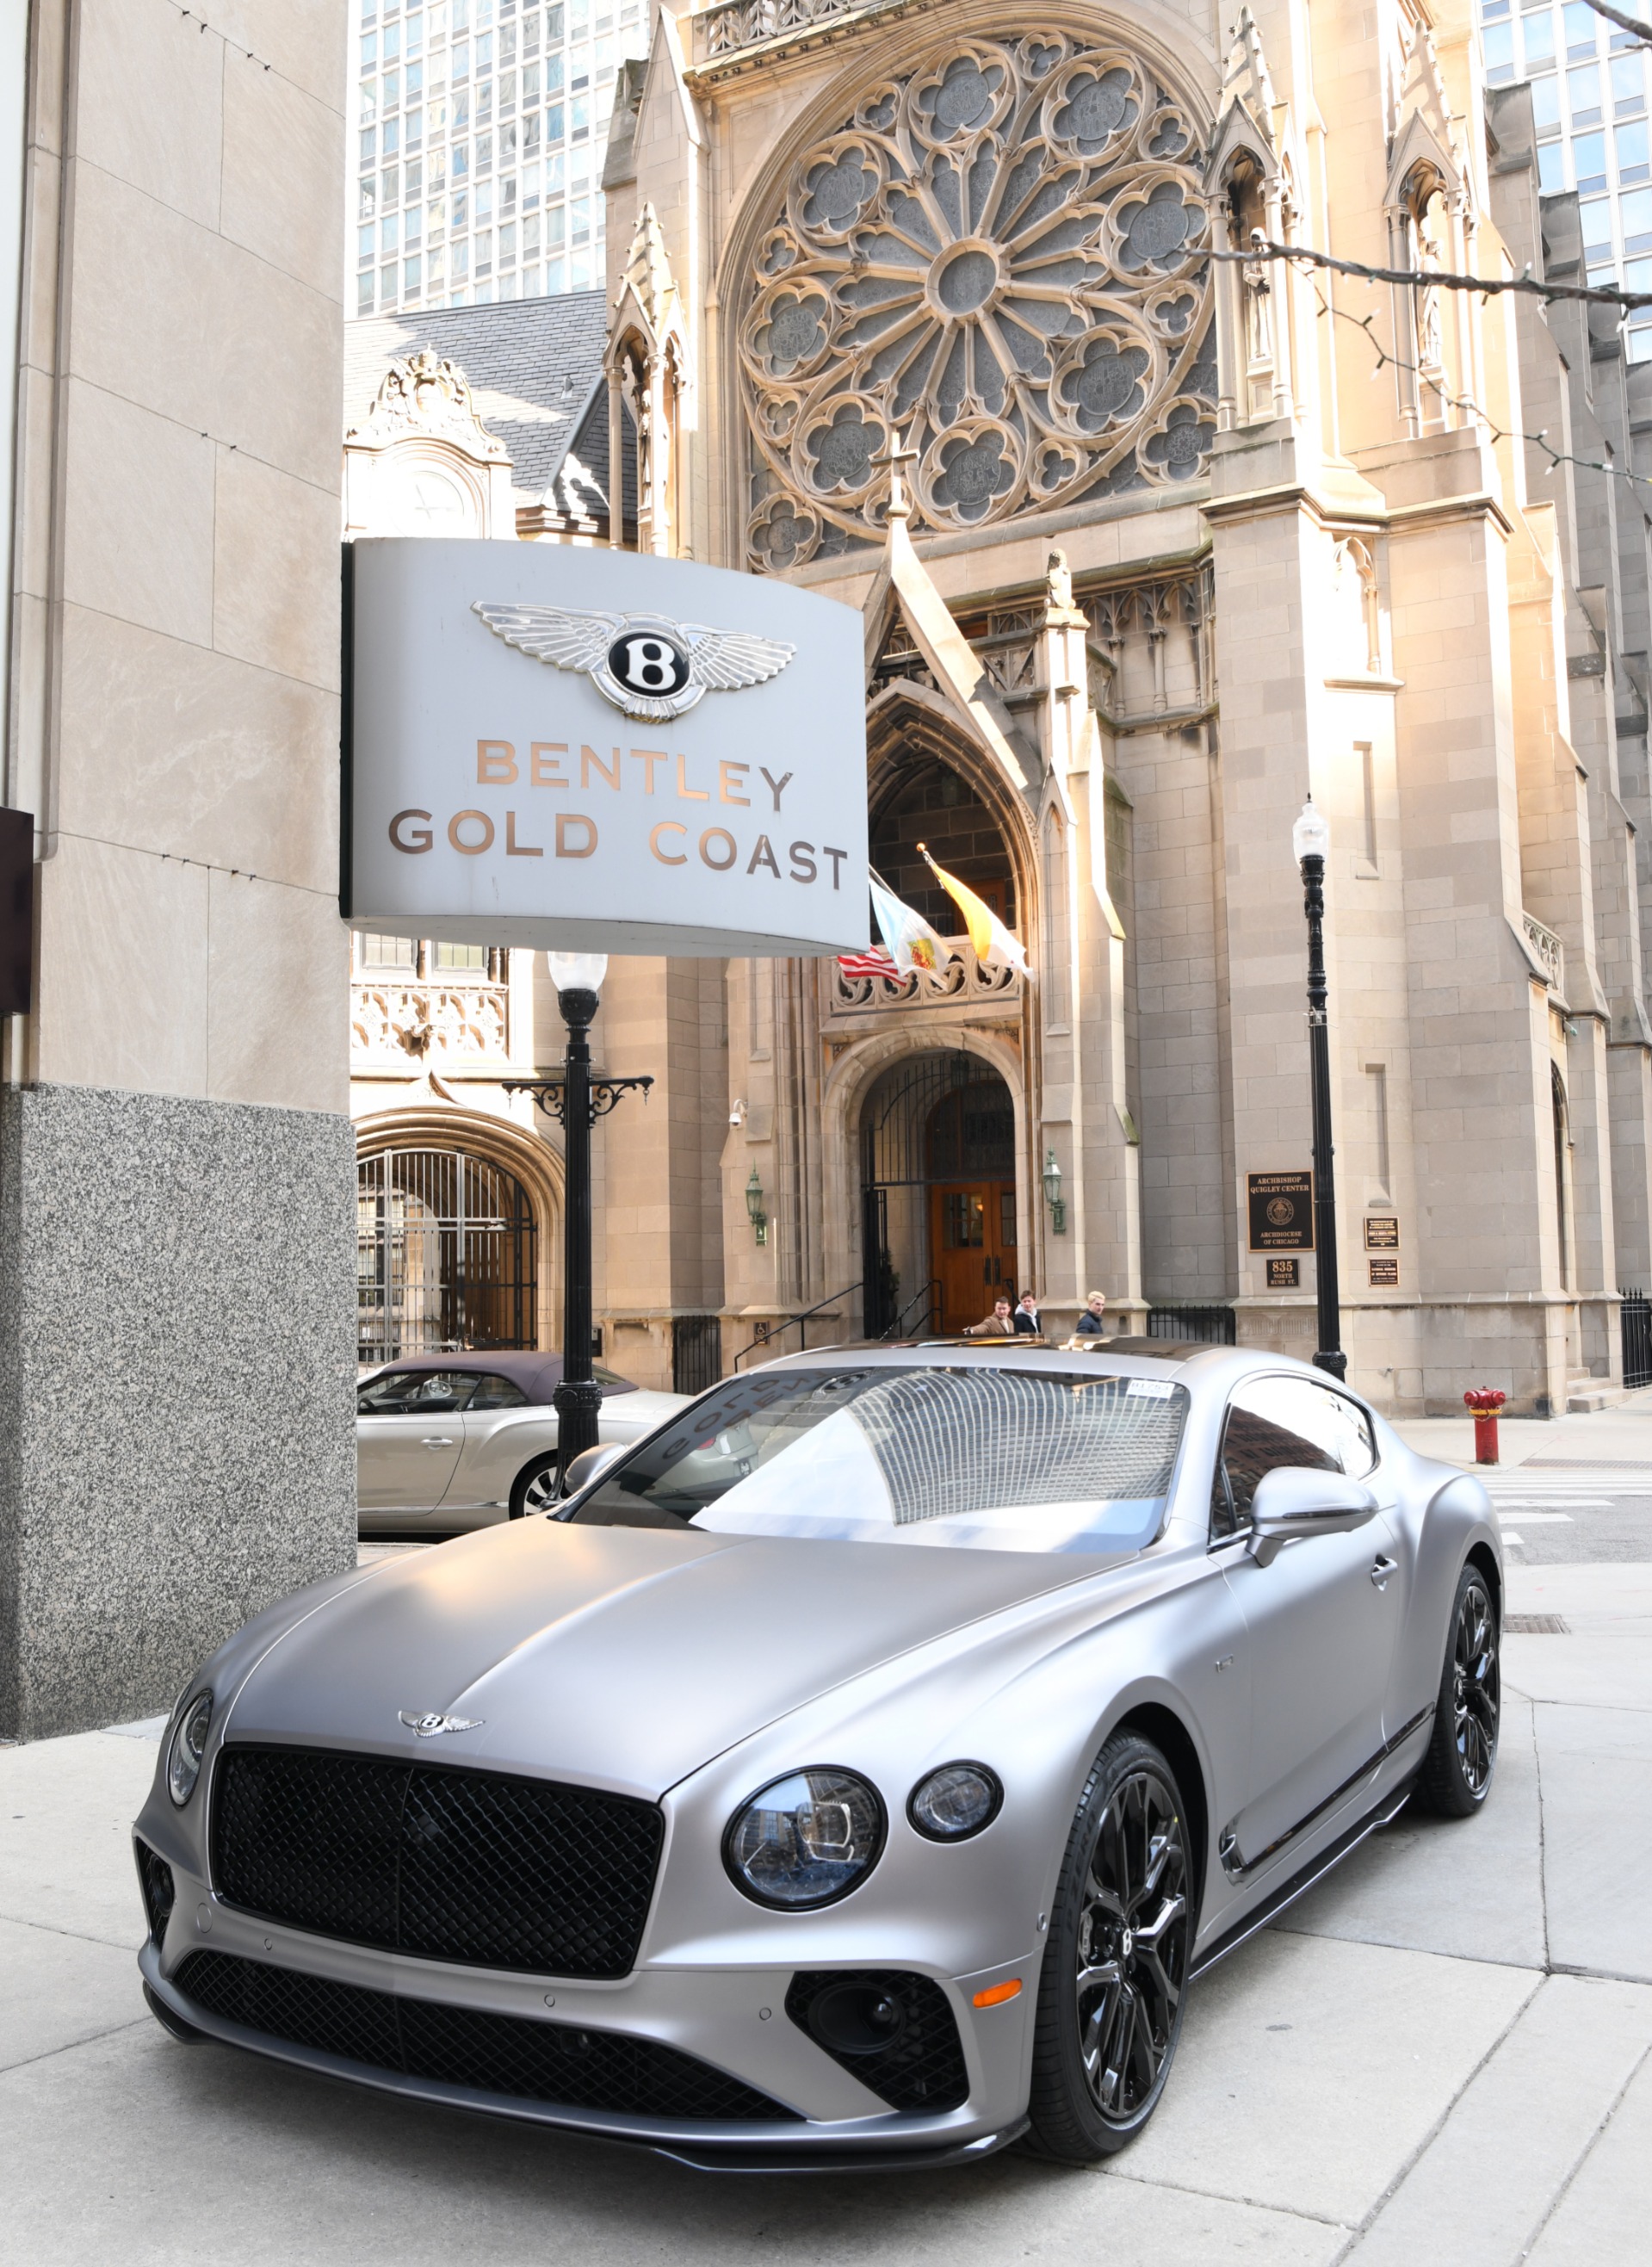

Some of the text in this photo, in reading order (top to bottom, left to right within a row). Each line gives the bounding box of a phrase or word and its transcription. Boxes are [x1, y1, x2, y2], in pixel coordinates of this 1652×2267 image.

[625, 638, 676, 691] B
[476, 740, 794, 812] BENTLEY
[388, 809, 848, 890] GOLD COAST
[1250, 1186, 1281, 1194] QUIGLEY
[1257, 1176, 1302, 1185] ARCHBISHOP
[1272, 1260, 1293, 1273] 835
